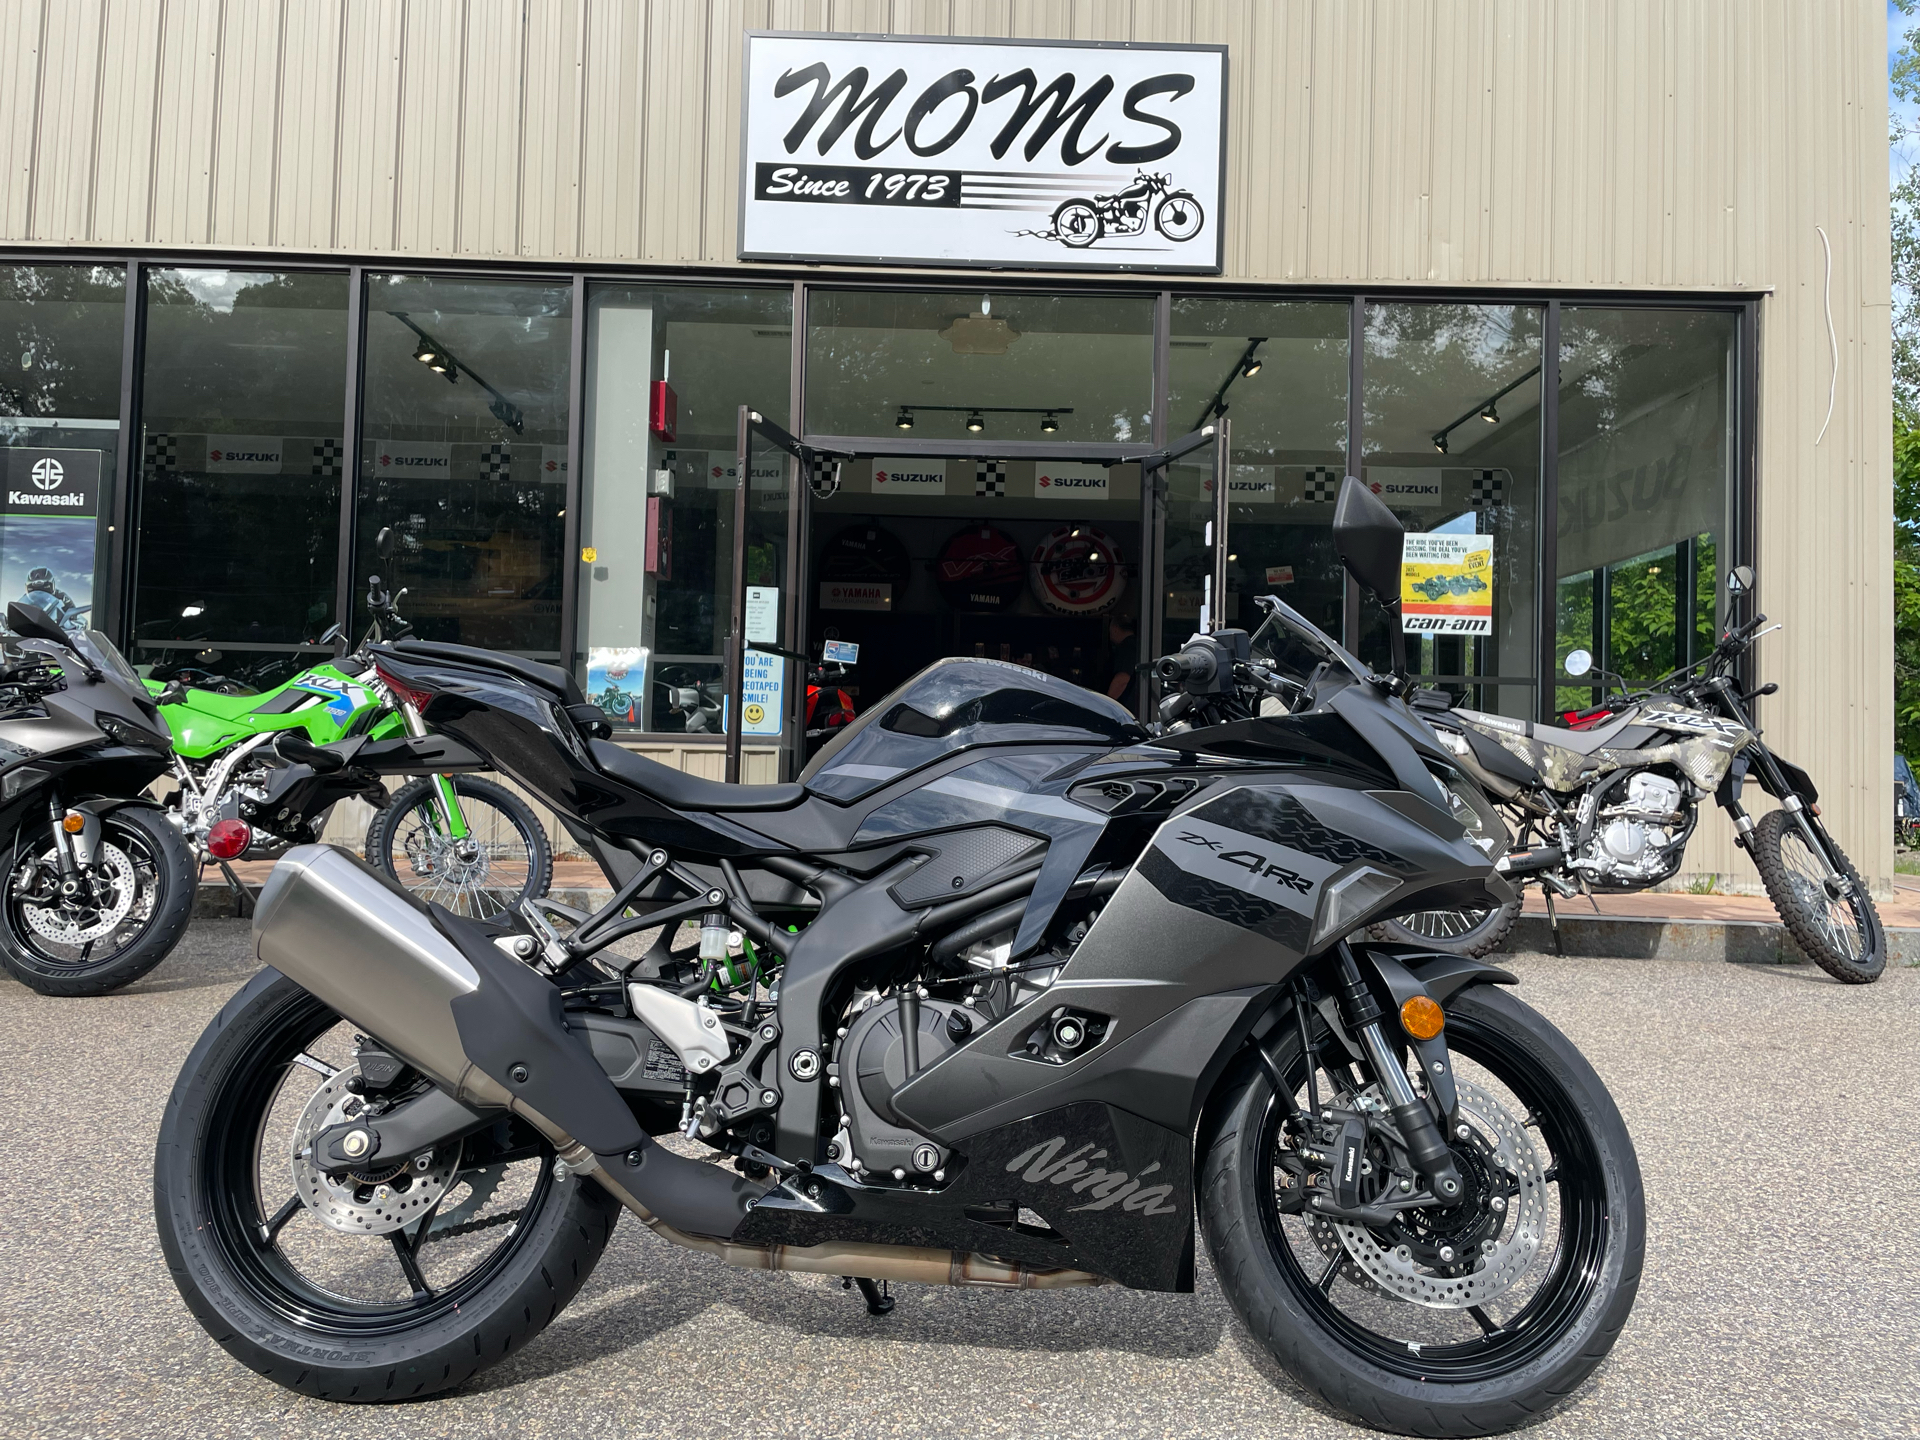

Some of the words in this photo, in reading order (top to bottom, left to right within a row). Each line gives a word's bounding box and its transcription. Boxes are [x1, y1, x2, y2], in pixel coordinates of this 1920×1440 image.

[773, 61, 1195, 166] MOMS
[765, 167, 850, 197] Since
[863, 172, 951, 201] 1973
[225, 452, 280, 462] SUZUKI
[395, 456, 448, 467] SUZUKI
[727, 468, 779, 478] SZUKI
[891, 473, 943, 483] SUZUKI
[1054, 477, 1106, 488] SUZUKI
[1229, 482, 1272, 491] UZUKI
[1386, 484, 1438, 494] SUZUKI
[8, 491, 84, 506] Kawasaki
[1468, 560, 1485, 570] EVENT
[843, 588, 881, 598] YAMAHA
[970, 593, 1000, 605] YAMAHA
[544, 604, 562, 613] YAM
[1404, 617, 1487, 631] can-am
[745, 656, 755, 666] OU
[758, 657, 774, 666] ARE
[745, 668, 768, 678] BEING
[294, 674, 369, 696] KLX
[743, 681, 779, 691] EOTAPED
[743, 692, 768, 703] SMILE!
[1478, 714, 1521, 732] Kawasaki
[1639, 710, 1748, 737] KLX
[869, 1136, 914, 1146] Kawasaki
[1345, 1146, 1356, 1182] Kawasaki
[1005, 1135, 1177, 1216] Ninja
